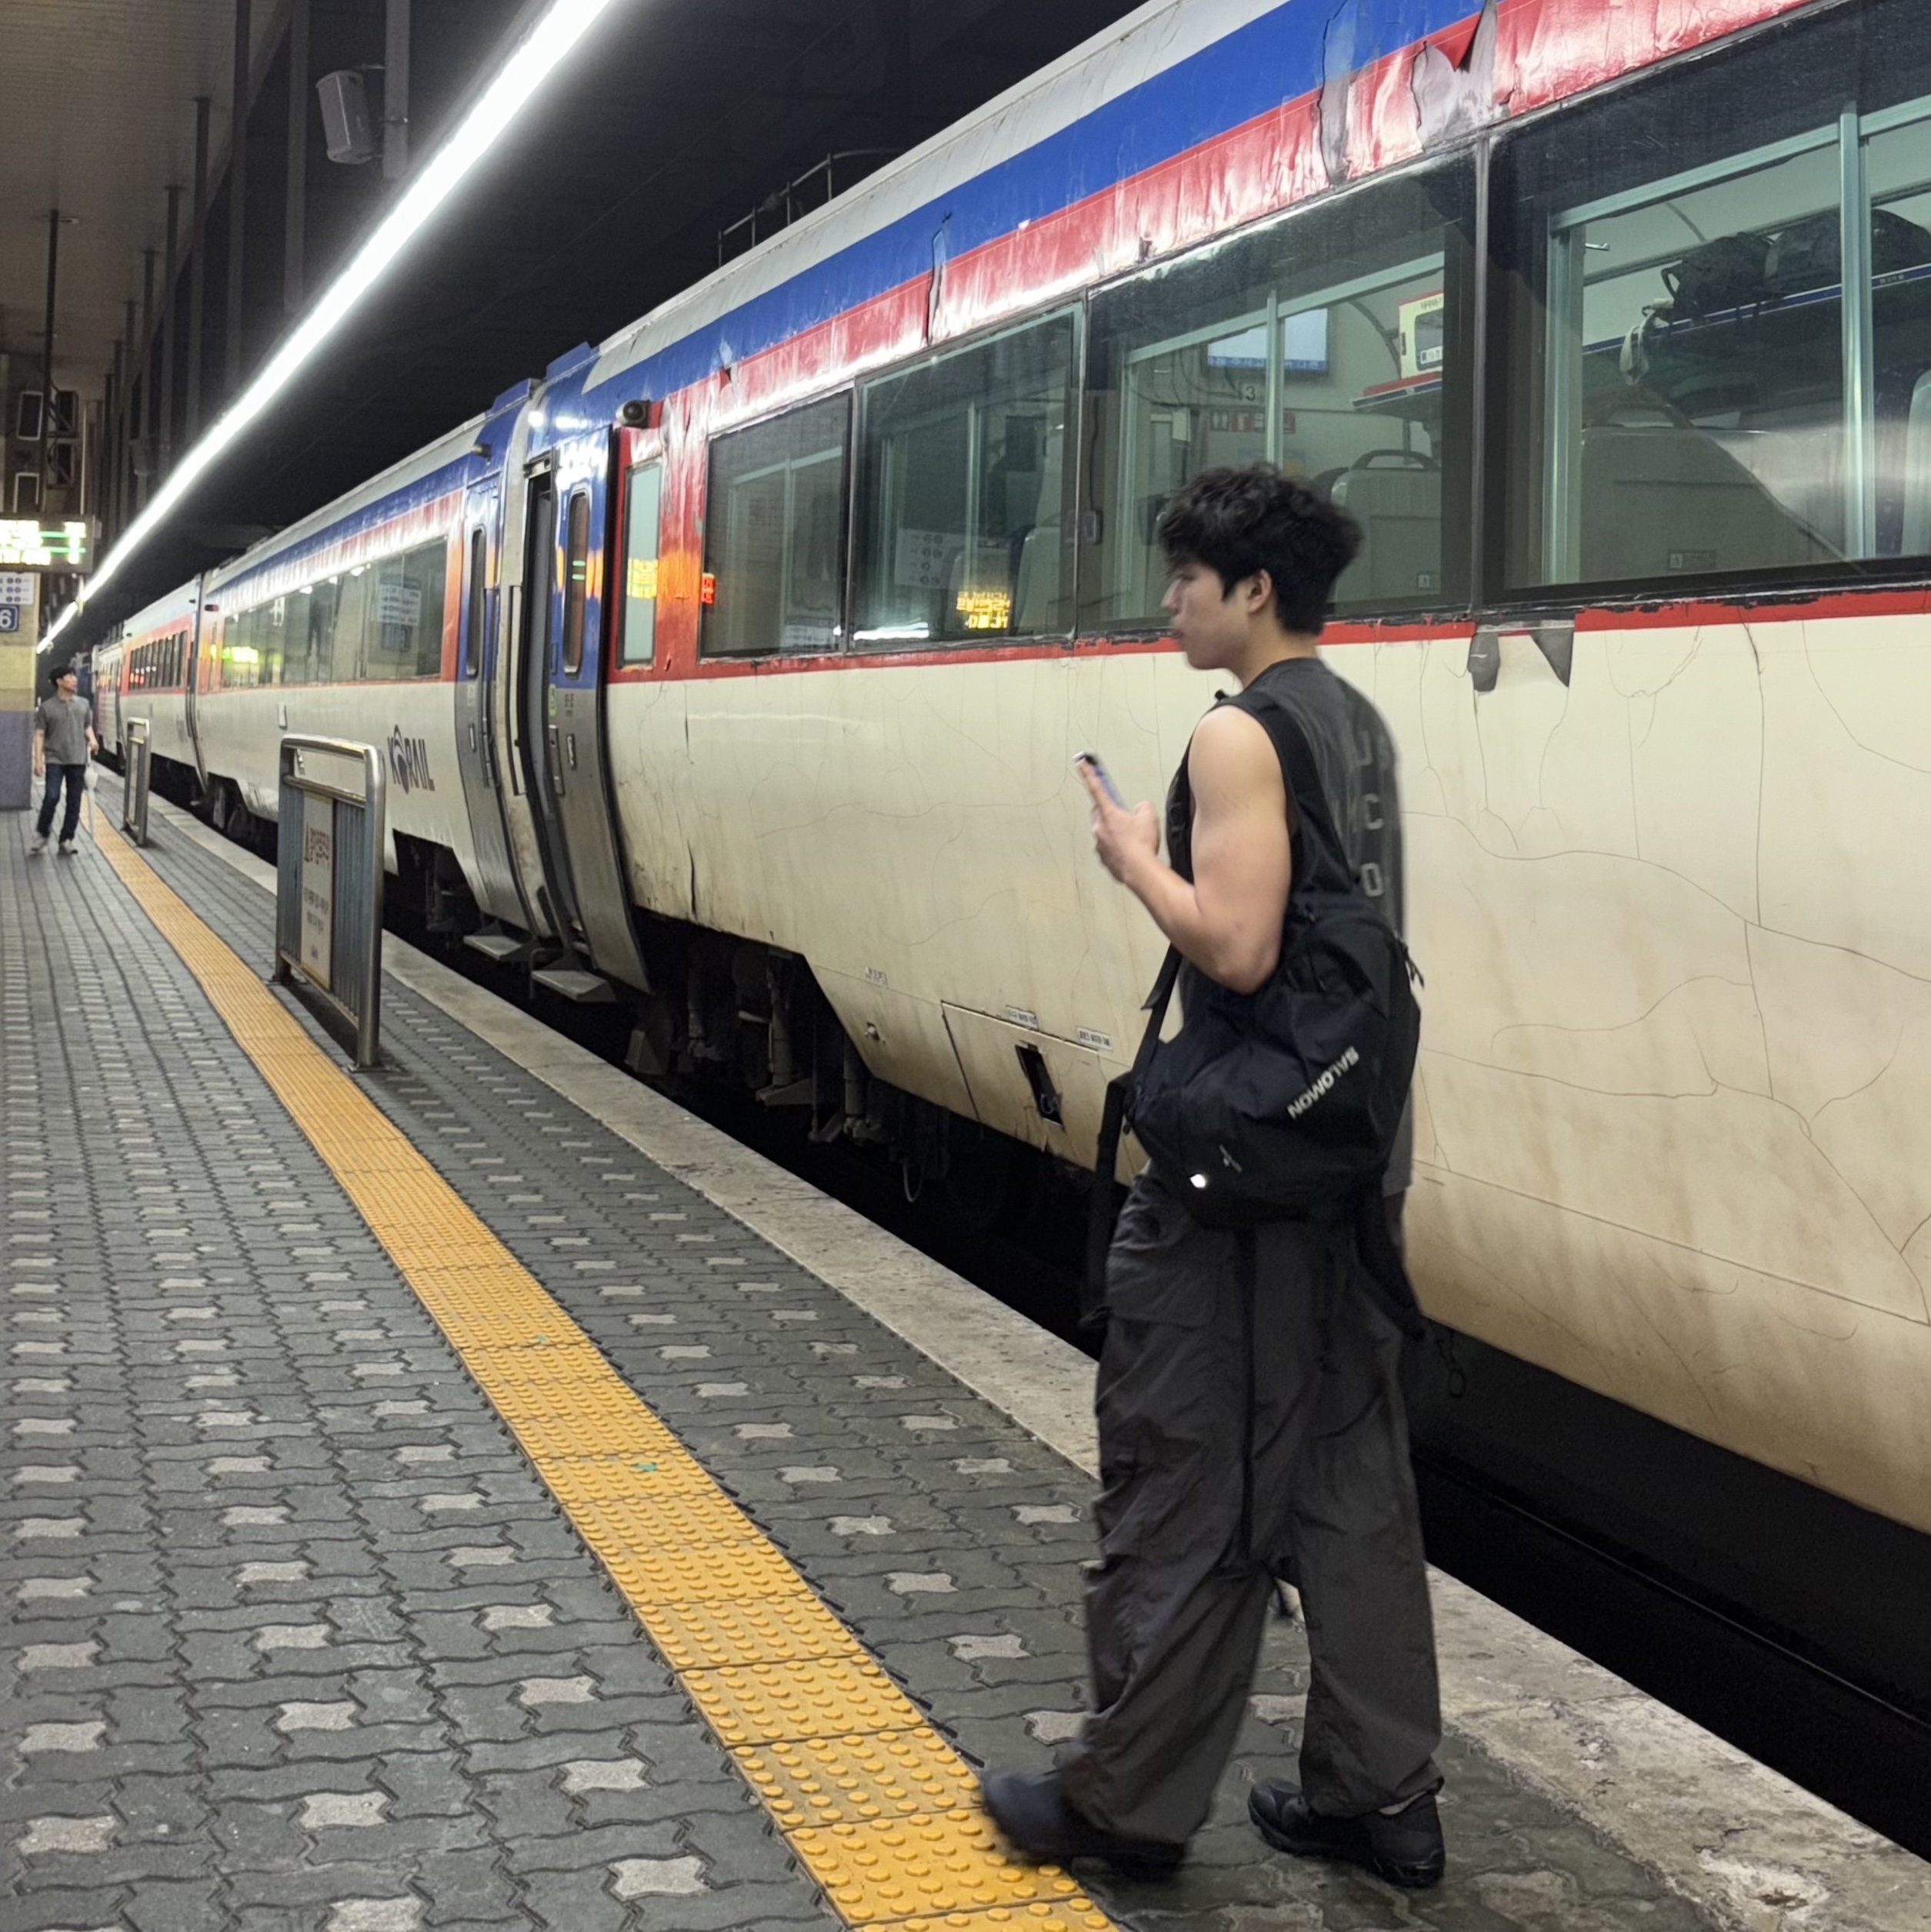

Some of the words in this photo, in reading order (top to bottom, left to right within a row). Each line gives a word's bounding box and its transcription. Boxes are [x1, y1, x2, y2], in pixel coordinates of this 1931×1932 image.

[1246, 385, 1256, 402] 3
[0, 609, 12, 629] 6
[387, 724, 435, 795] KORAIL
[1286, 1045, 1359, 1119] SALOMON
